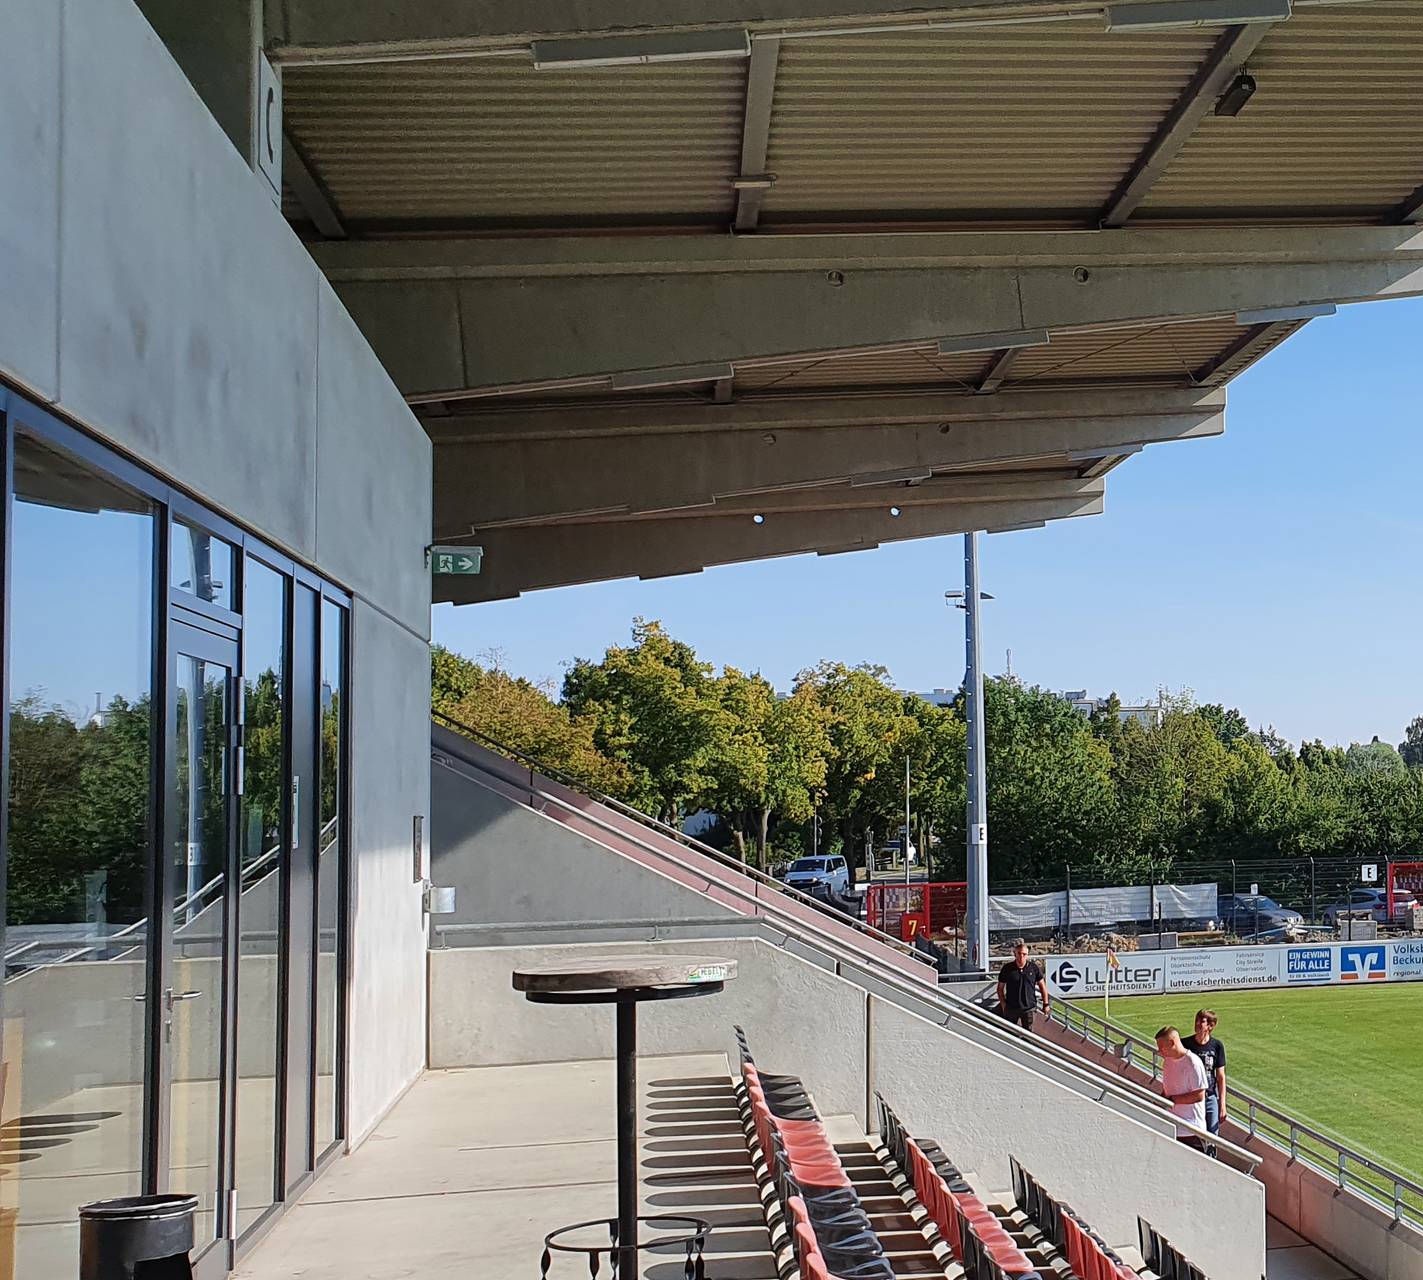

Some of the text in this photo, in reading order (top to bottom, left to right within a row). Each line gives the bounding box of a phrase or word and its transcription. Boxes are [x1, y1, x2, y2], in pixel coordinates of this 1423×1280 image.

[1367, 867, 1373, 878] E
[908, 920, 918, 936] 7
[1289, 950, 1330, 960] EIN GEWINN
[1289, 959, 1330, 971] FÜR ALLE
[1085, 966, 1161, 985] Lutter
[1170, 974, 1277, 987] lutter-sicherheitsdienst.de
